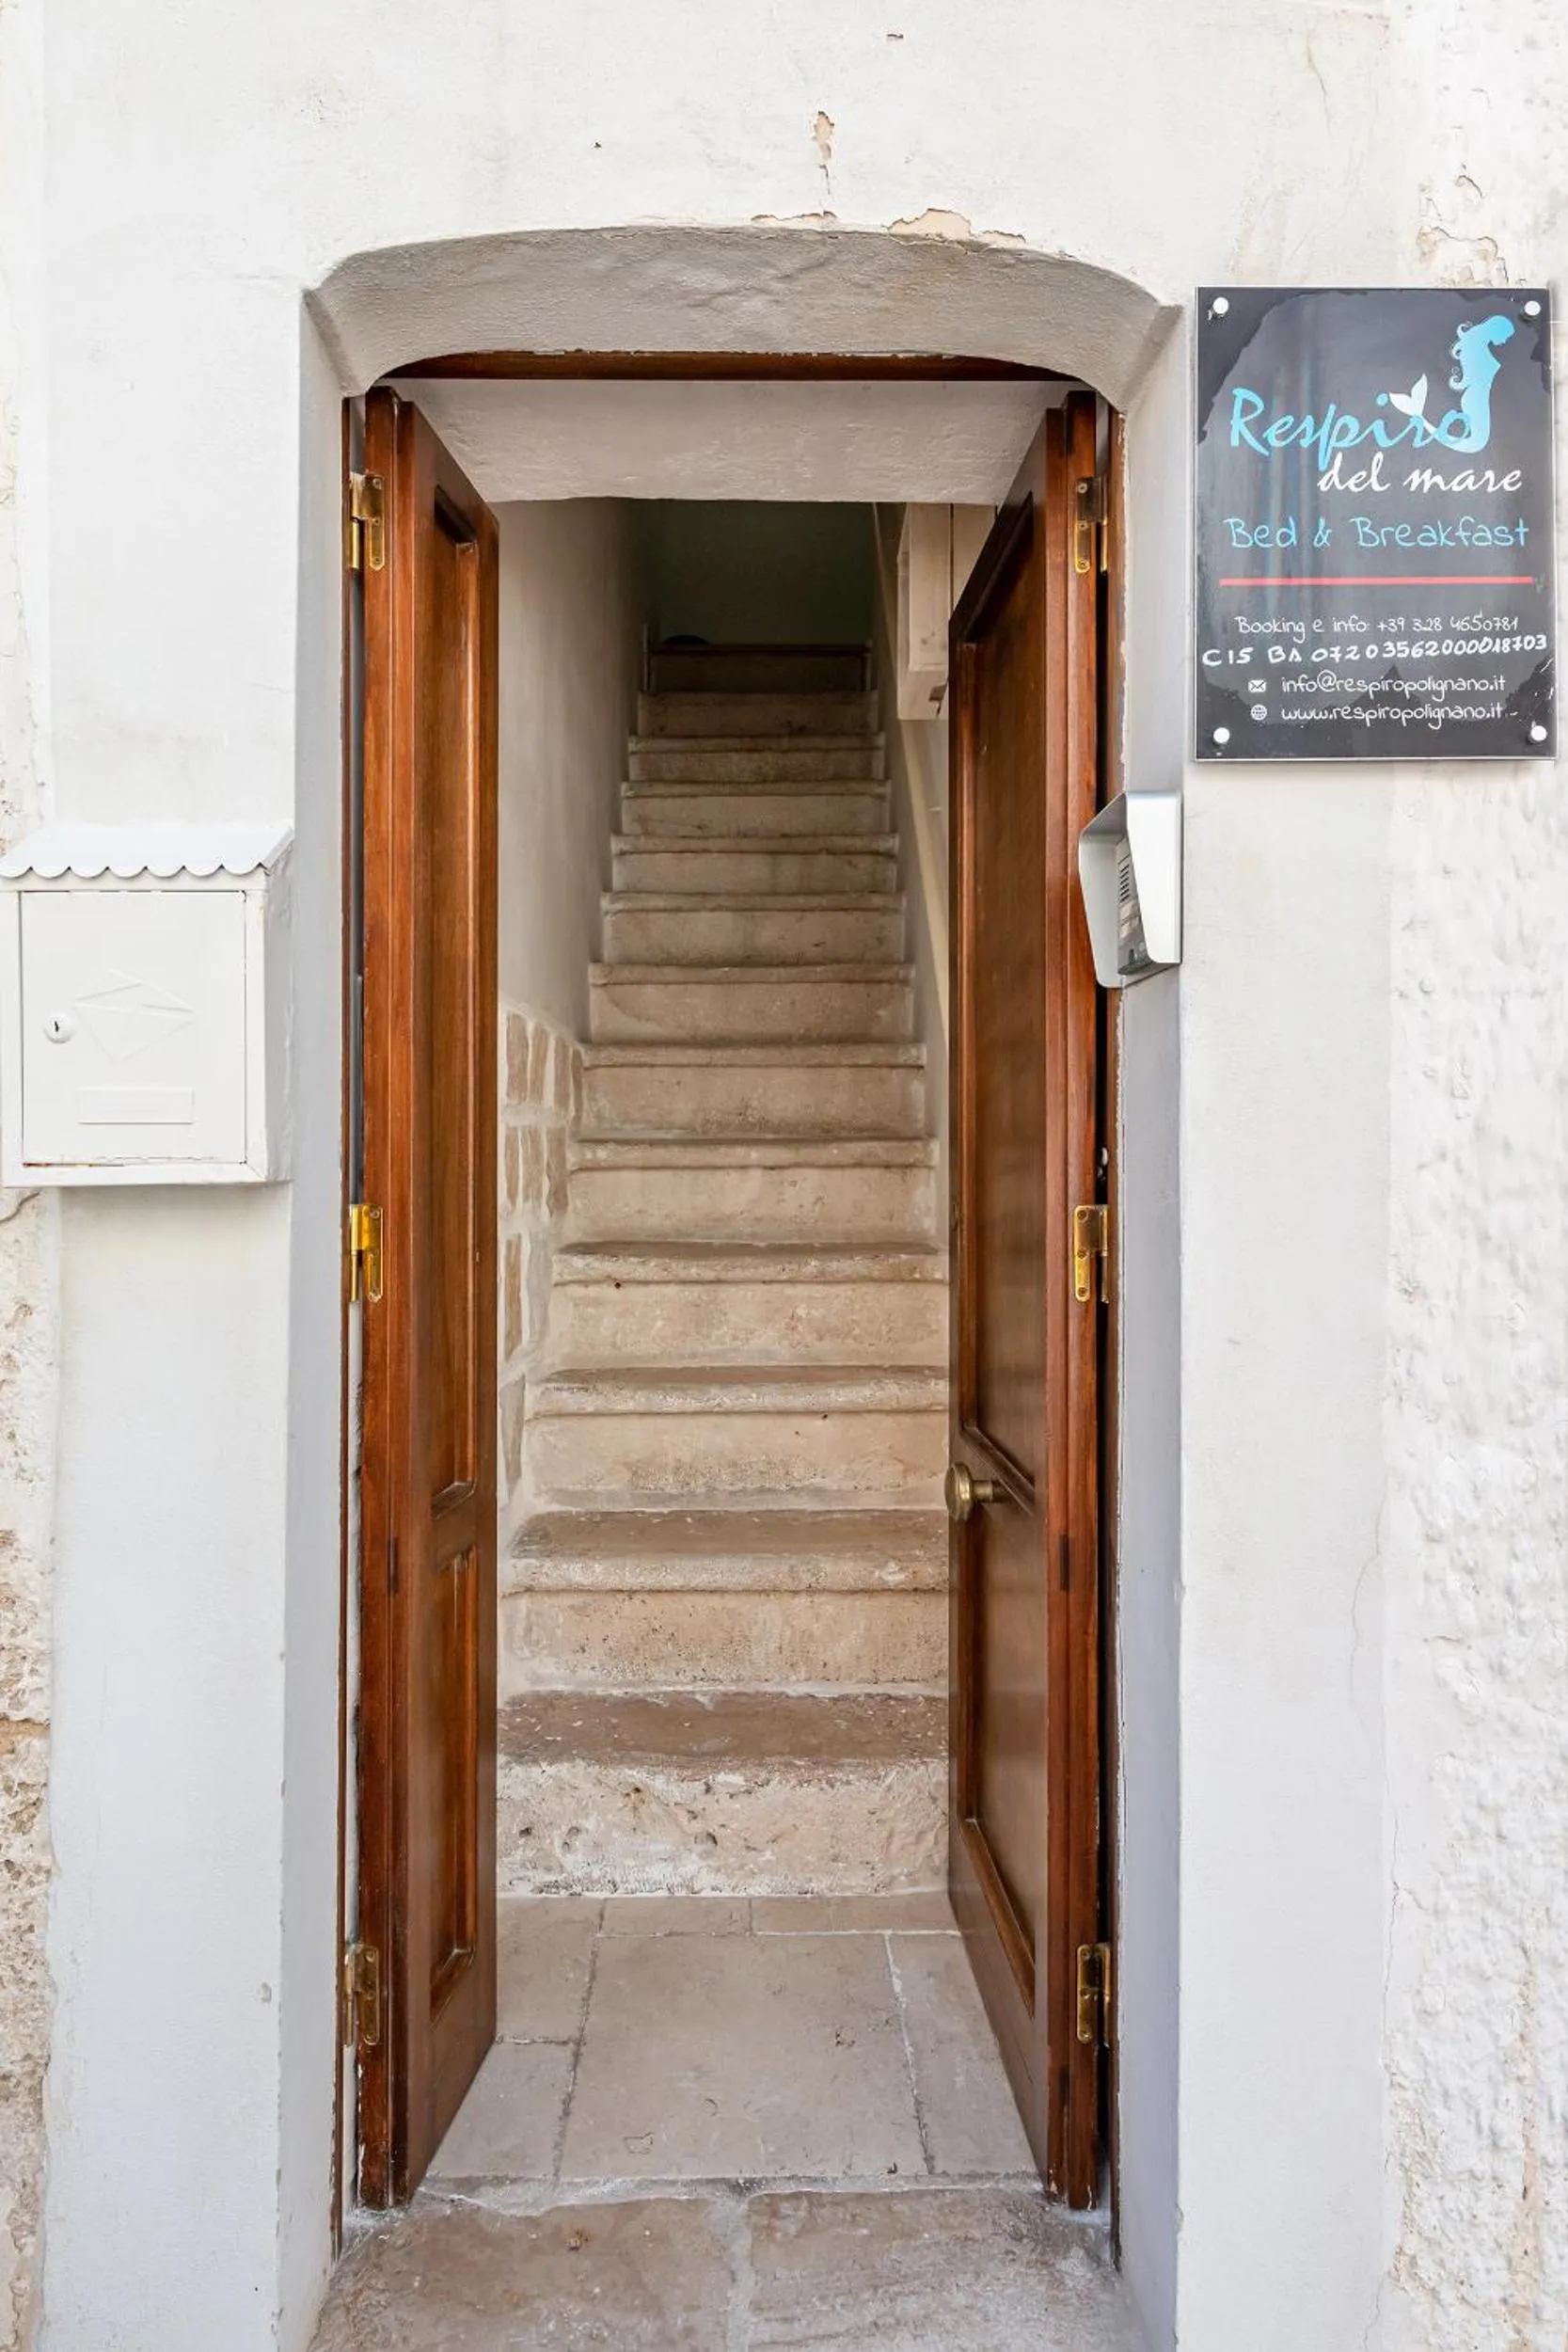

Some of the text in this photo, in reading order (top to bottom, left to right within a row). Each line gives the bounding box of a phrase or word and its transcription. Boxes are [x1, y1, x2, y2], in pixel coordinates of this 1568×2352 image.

[1229, 387, 1473, 472] Respiro
[1317, 452, 1523, 493] del mare
[1224, 516, 1529, 548] Bed & Breakfast
[1234, 615, 1306, 644] Booking
[1312, 618, 1325, 633] e
[1377, 617, 1405, 632] +39
[1412, 617, 1443, 631] 328
[1449, 613, 1519, 632] 4650781
[1267, 645, 1303, 663] BA
[1281, 670, 1506, 702] info@respiropolignano.it
[1281, 702, 1504, 730] www.respiropolignano.it
